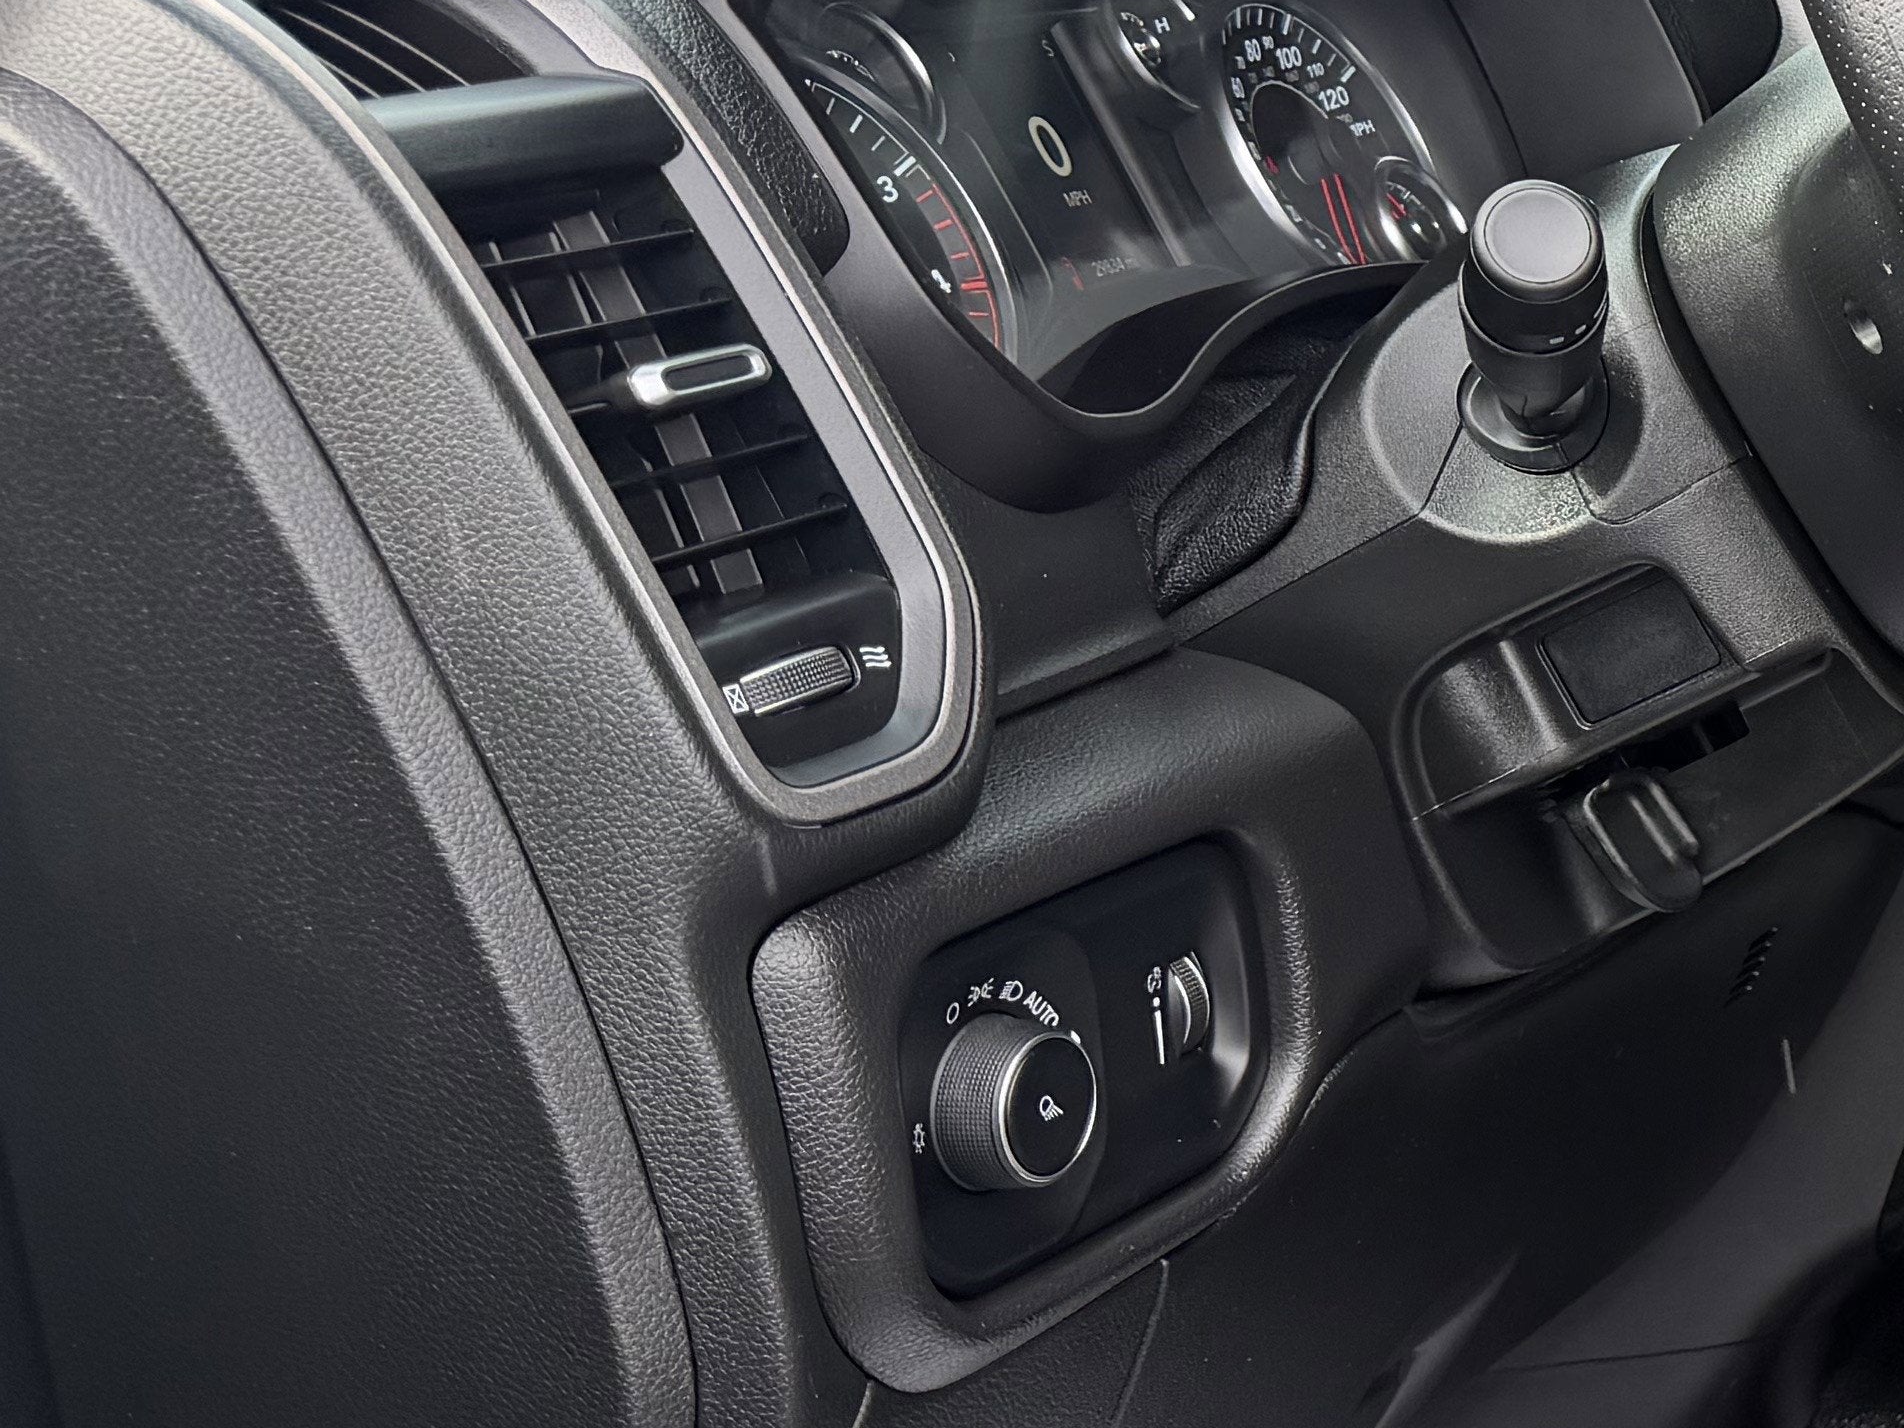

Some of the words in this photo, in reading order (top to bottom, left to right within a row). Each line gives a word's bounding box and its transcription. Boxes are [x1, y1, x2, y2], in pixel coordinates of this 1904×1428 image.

[1245, 39, 1261, 62] 80
[1276, 46, 1302, 69] 100
[1307, 63, 1324, 78] 110
[1318, 86, 1349, 111] 120
[1028, 116, 1072, 177] 0
[876, 175, 899, 203] 3
[1063, 189, 1093, 207] MPH
[1023, 991, 1059, 1026] AUTO
